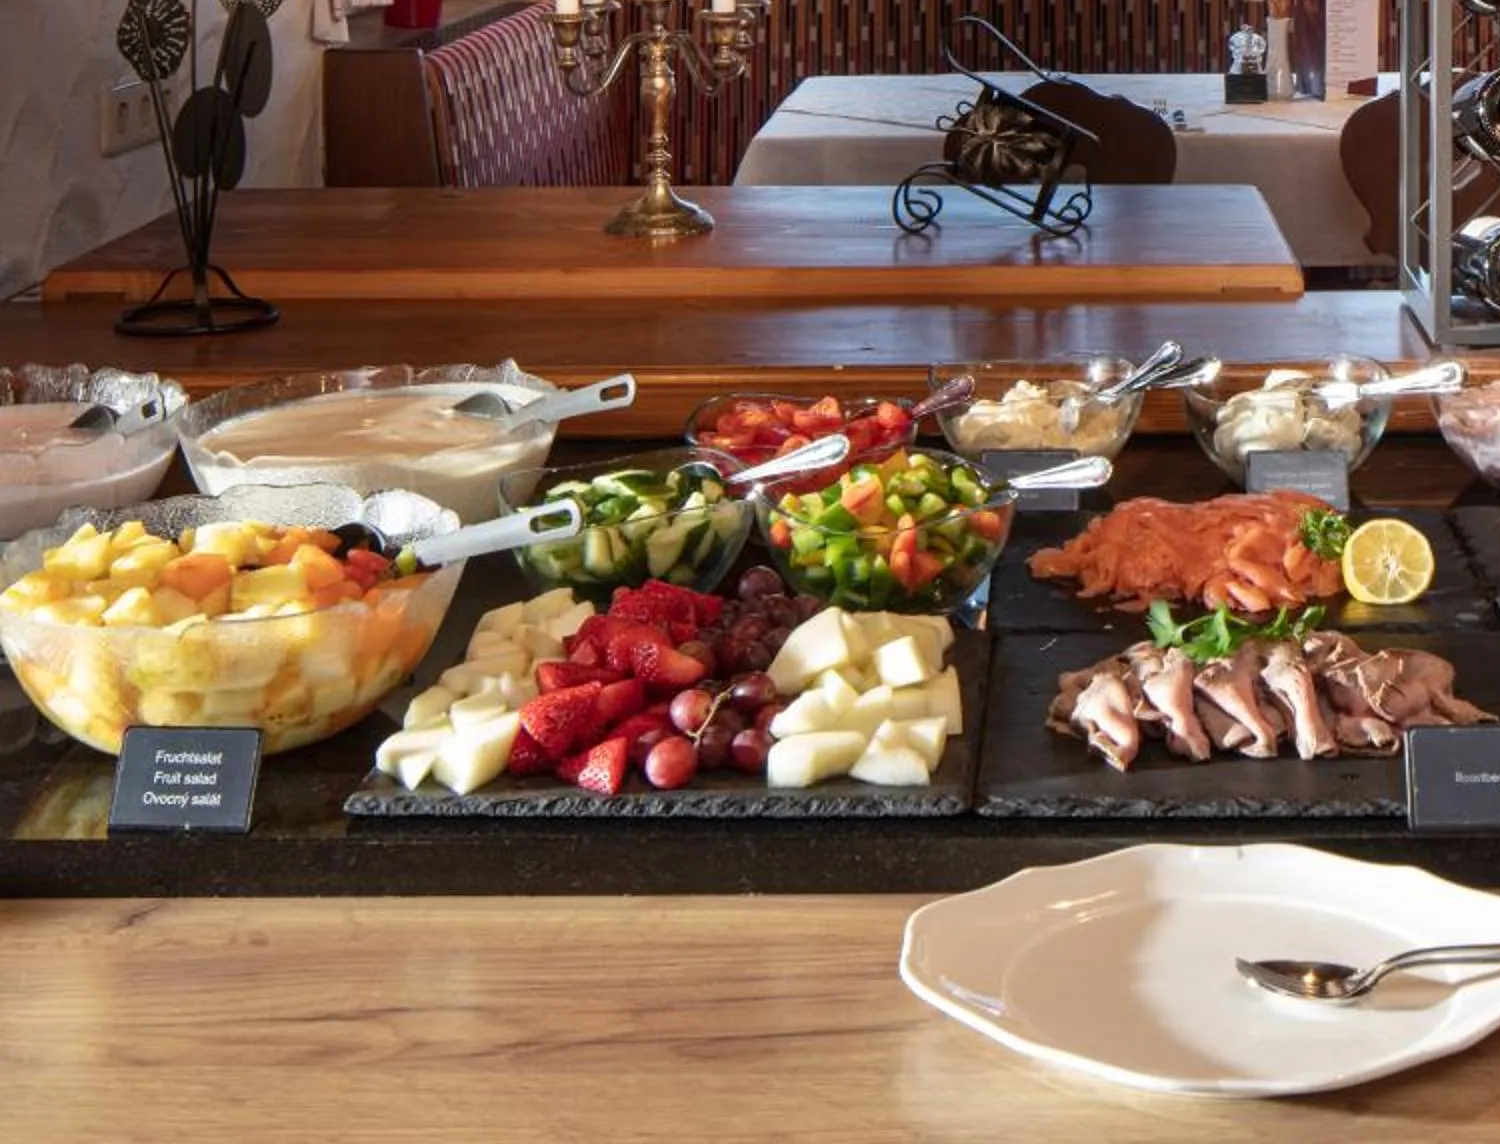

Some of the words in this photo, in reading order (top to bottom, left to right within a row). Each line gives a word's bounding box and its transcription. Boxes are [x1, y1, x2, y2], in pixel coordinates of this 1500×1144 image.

[155, 749, 223, 765] Fruchtsalat
[153, 770, 181, 785] Fruit
[183, 772, 217, 785] salad
[143, 791, 190, 808] Ovocný
[191, 792, 223, 807] salát
